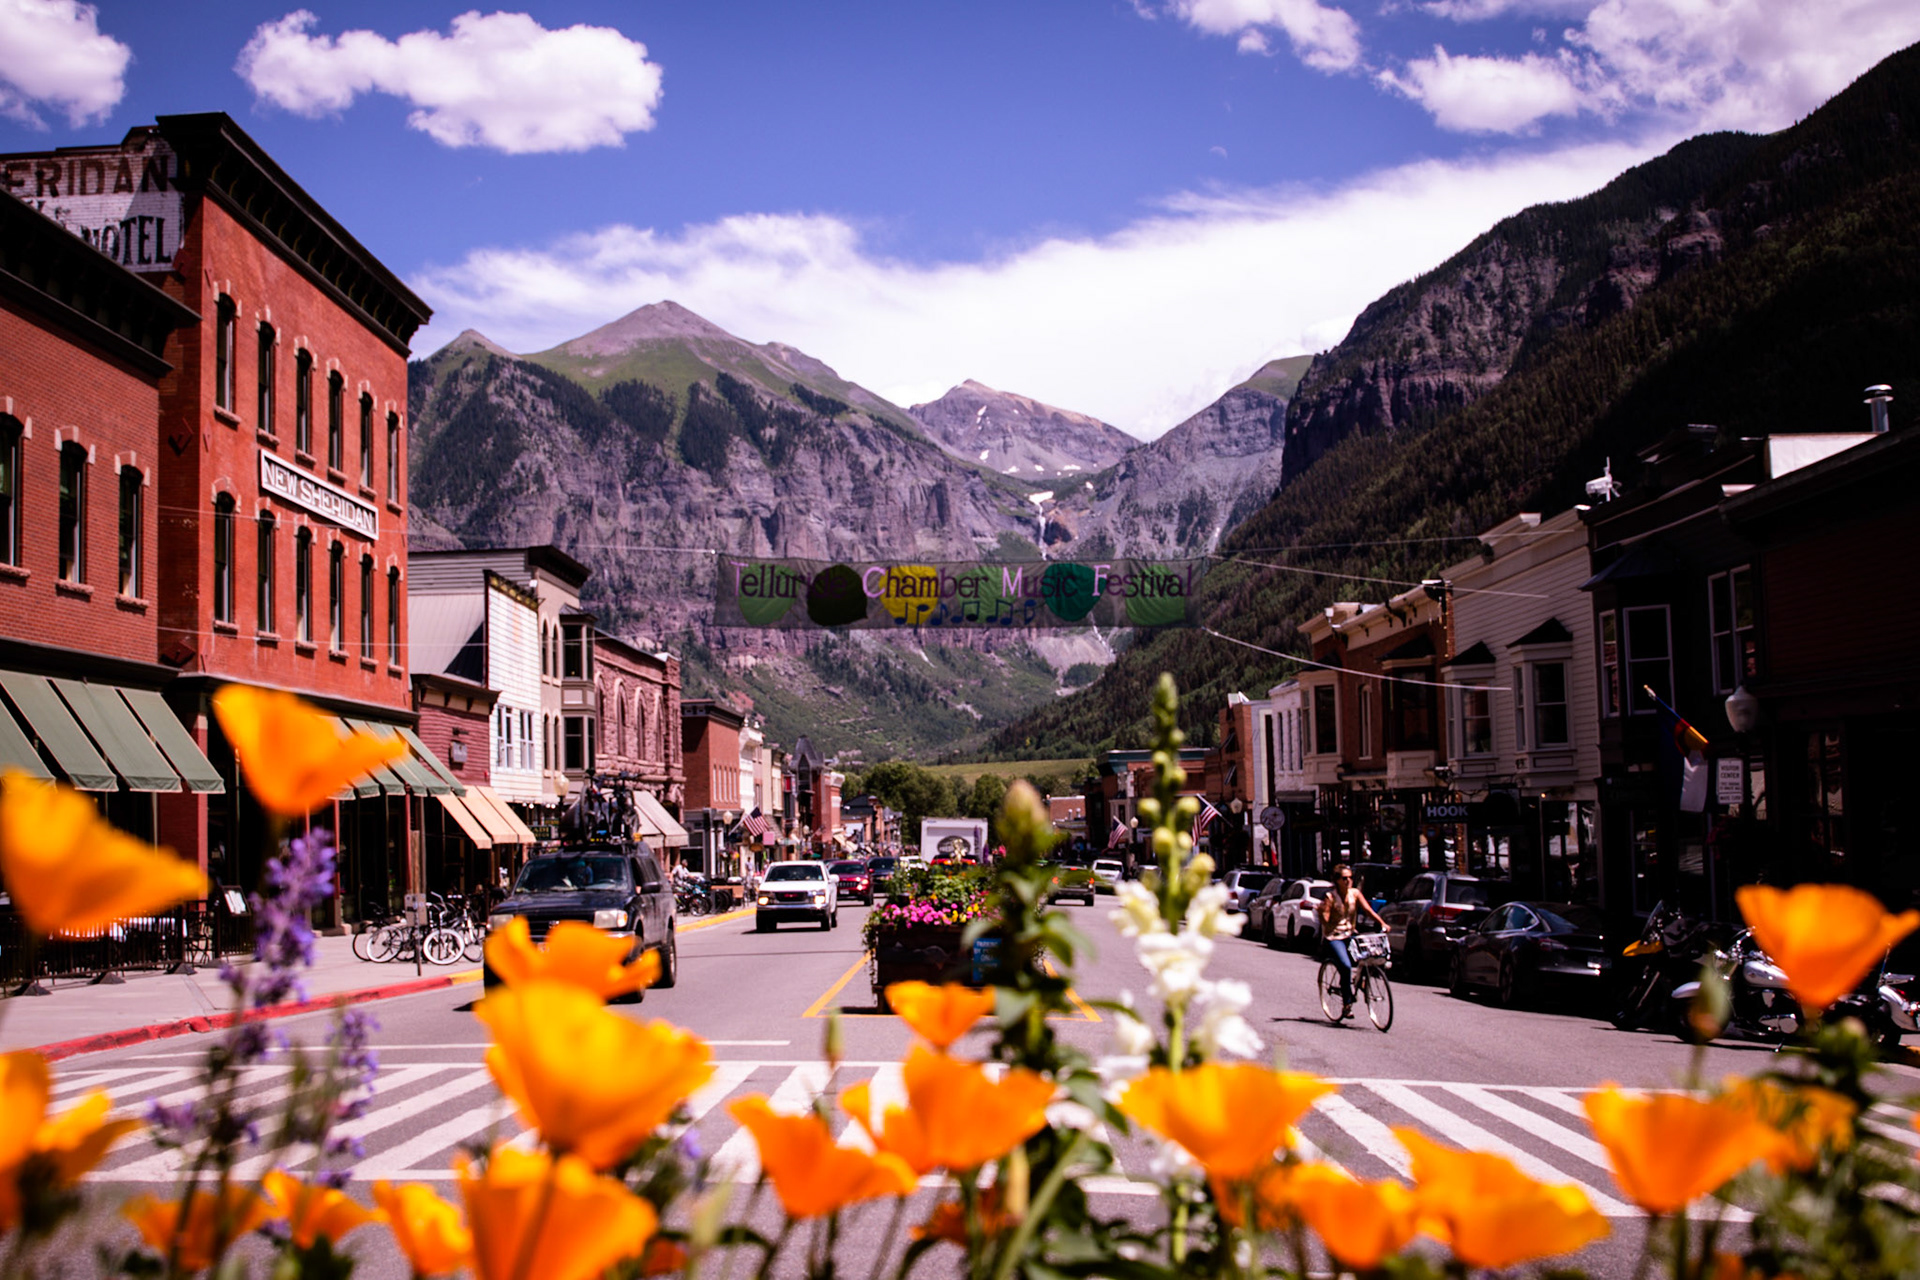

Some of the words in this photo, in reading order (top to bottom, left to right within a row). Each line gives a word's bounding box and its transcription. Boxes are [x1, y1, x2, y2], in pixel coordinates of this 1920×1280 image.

[264, 460, 297, 496] NEW
[300, 479, 375, 534] SHERIDAN
[730, 561, 847, 599] Telluride
[862, 565, 988, 599] Chamber
[1002, 565, 1078, 598] Music
[1092, 563, 1193, 598] Festival
[1427, 806, 1468, 817] HOOK
